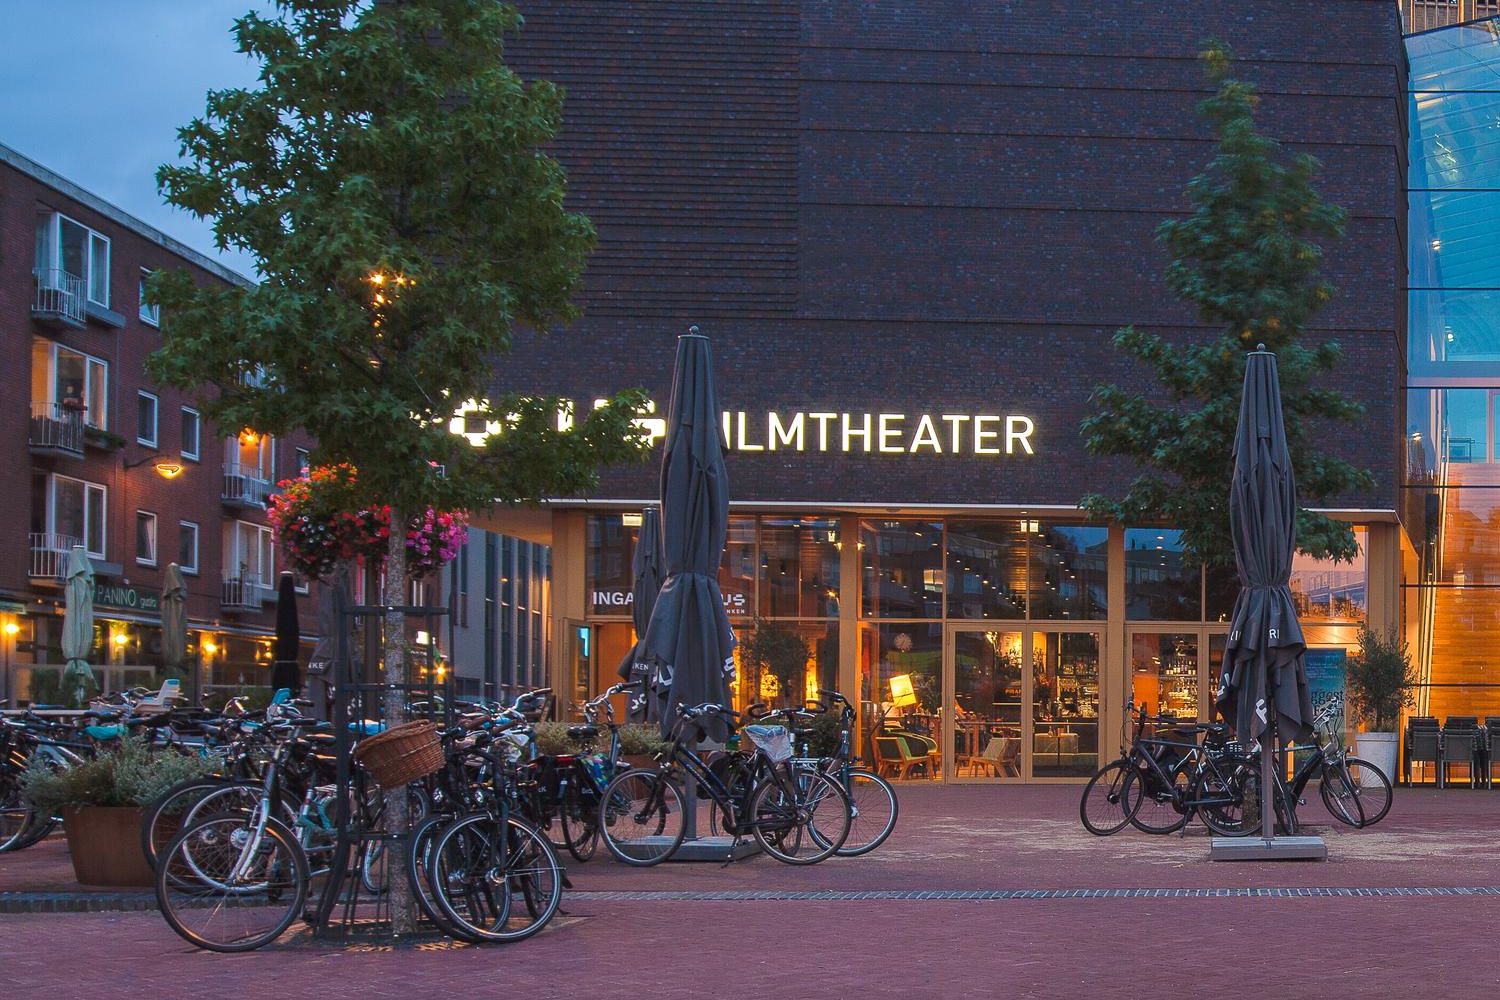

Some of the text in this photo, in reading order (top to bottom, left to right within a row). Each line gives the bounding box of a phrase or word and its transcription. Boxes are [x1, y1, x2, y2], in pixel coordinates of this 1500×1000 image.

[722, 411, 1035, 455] ILMTHEATER
[98, 585, 136, 606] PANINO
[592, 591, 634, 605] INGA
